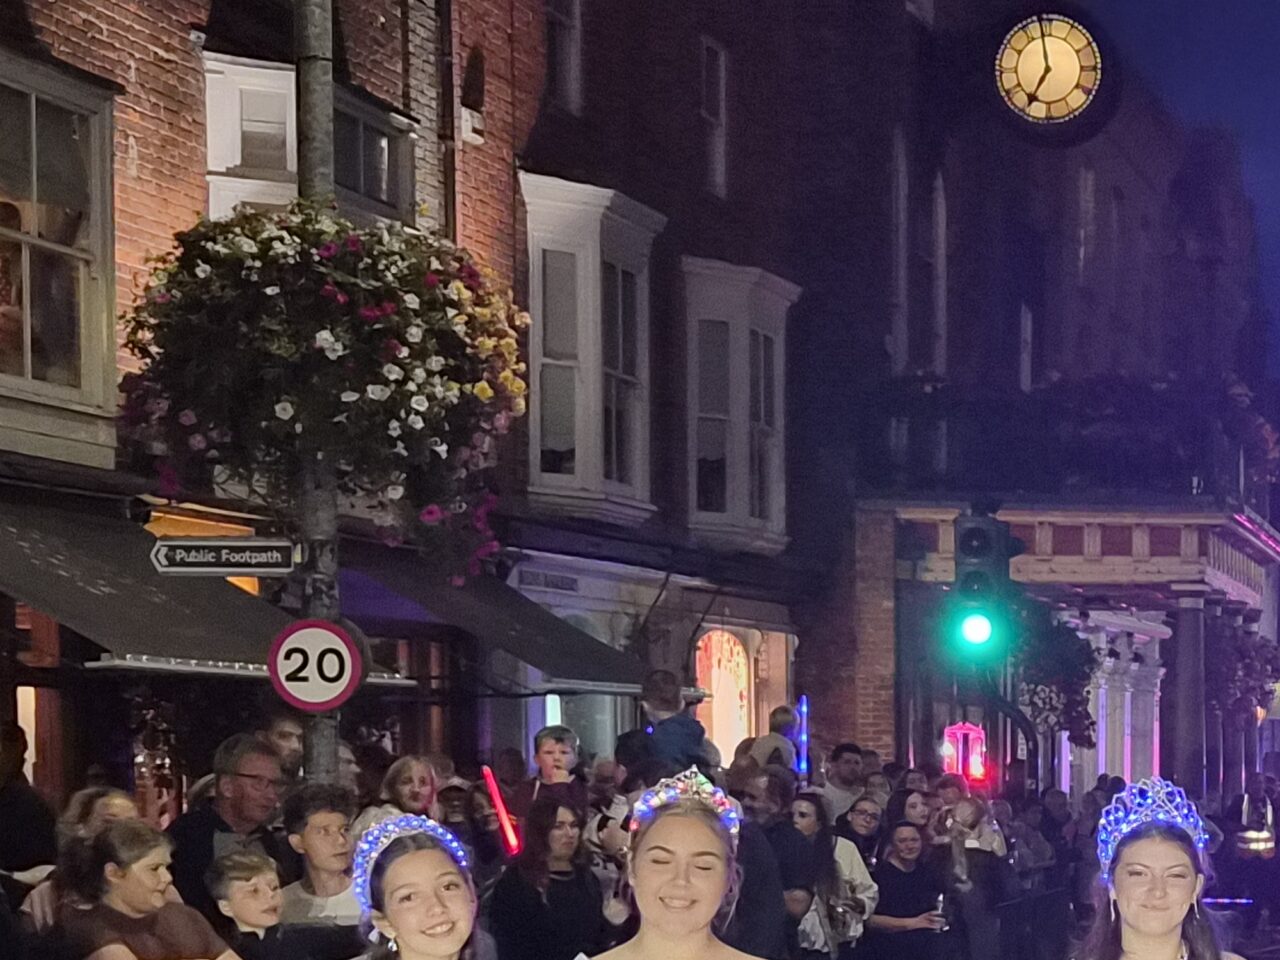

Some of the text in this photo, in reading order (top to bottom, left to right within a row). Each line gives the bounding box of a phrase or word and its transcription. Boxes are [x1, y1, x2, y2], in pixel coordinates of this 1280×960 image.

[175, 549, 282, 565] Public Footpath
[283, 646, 346, 684] 20
